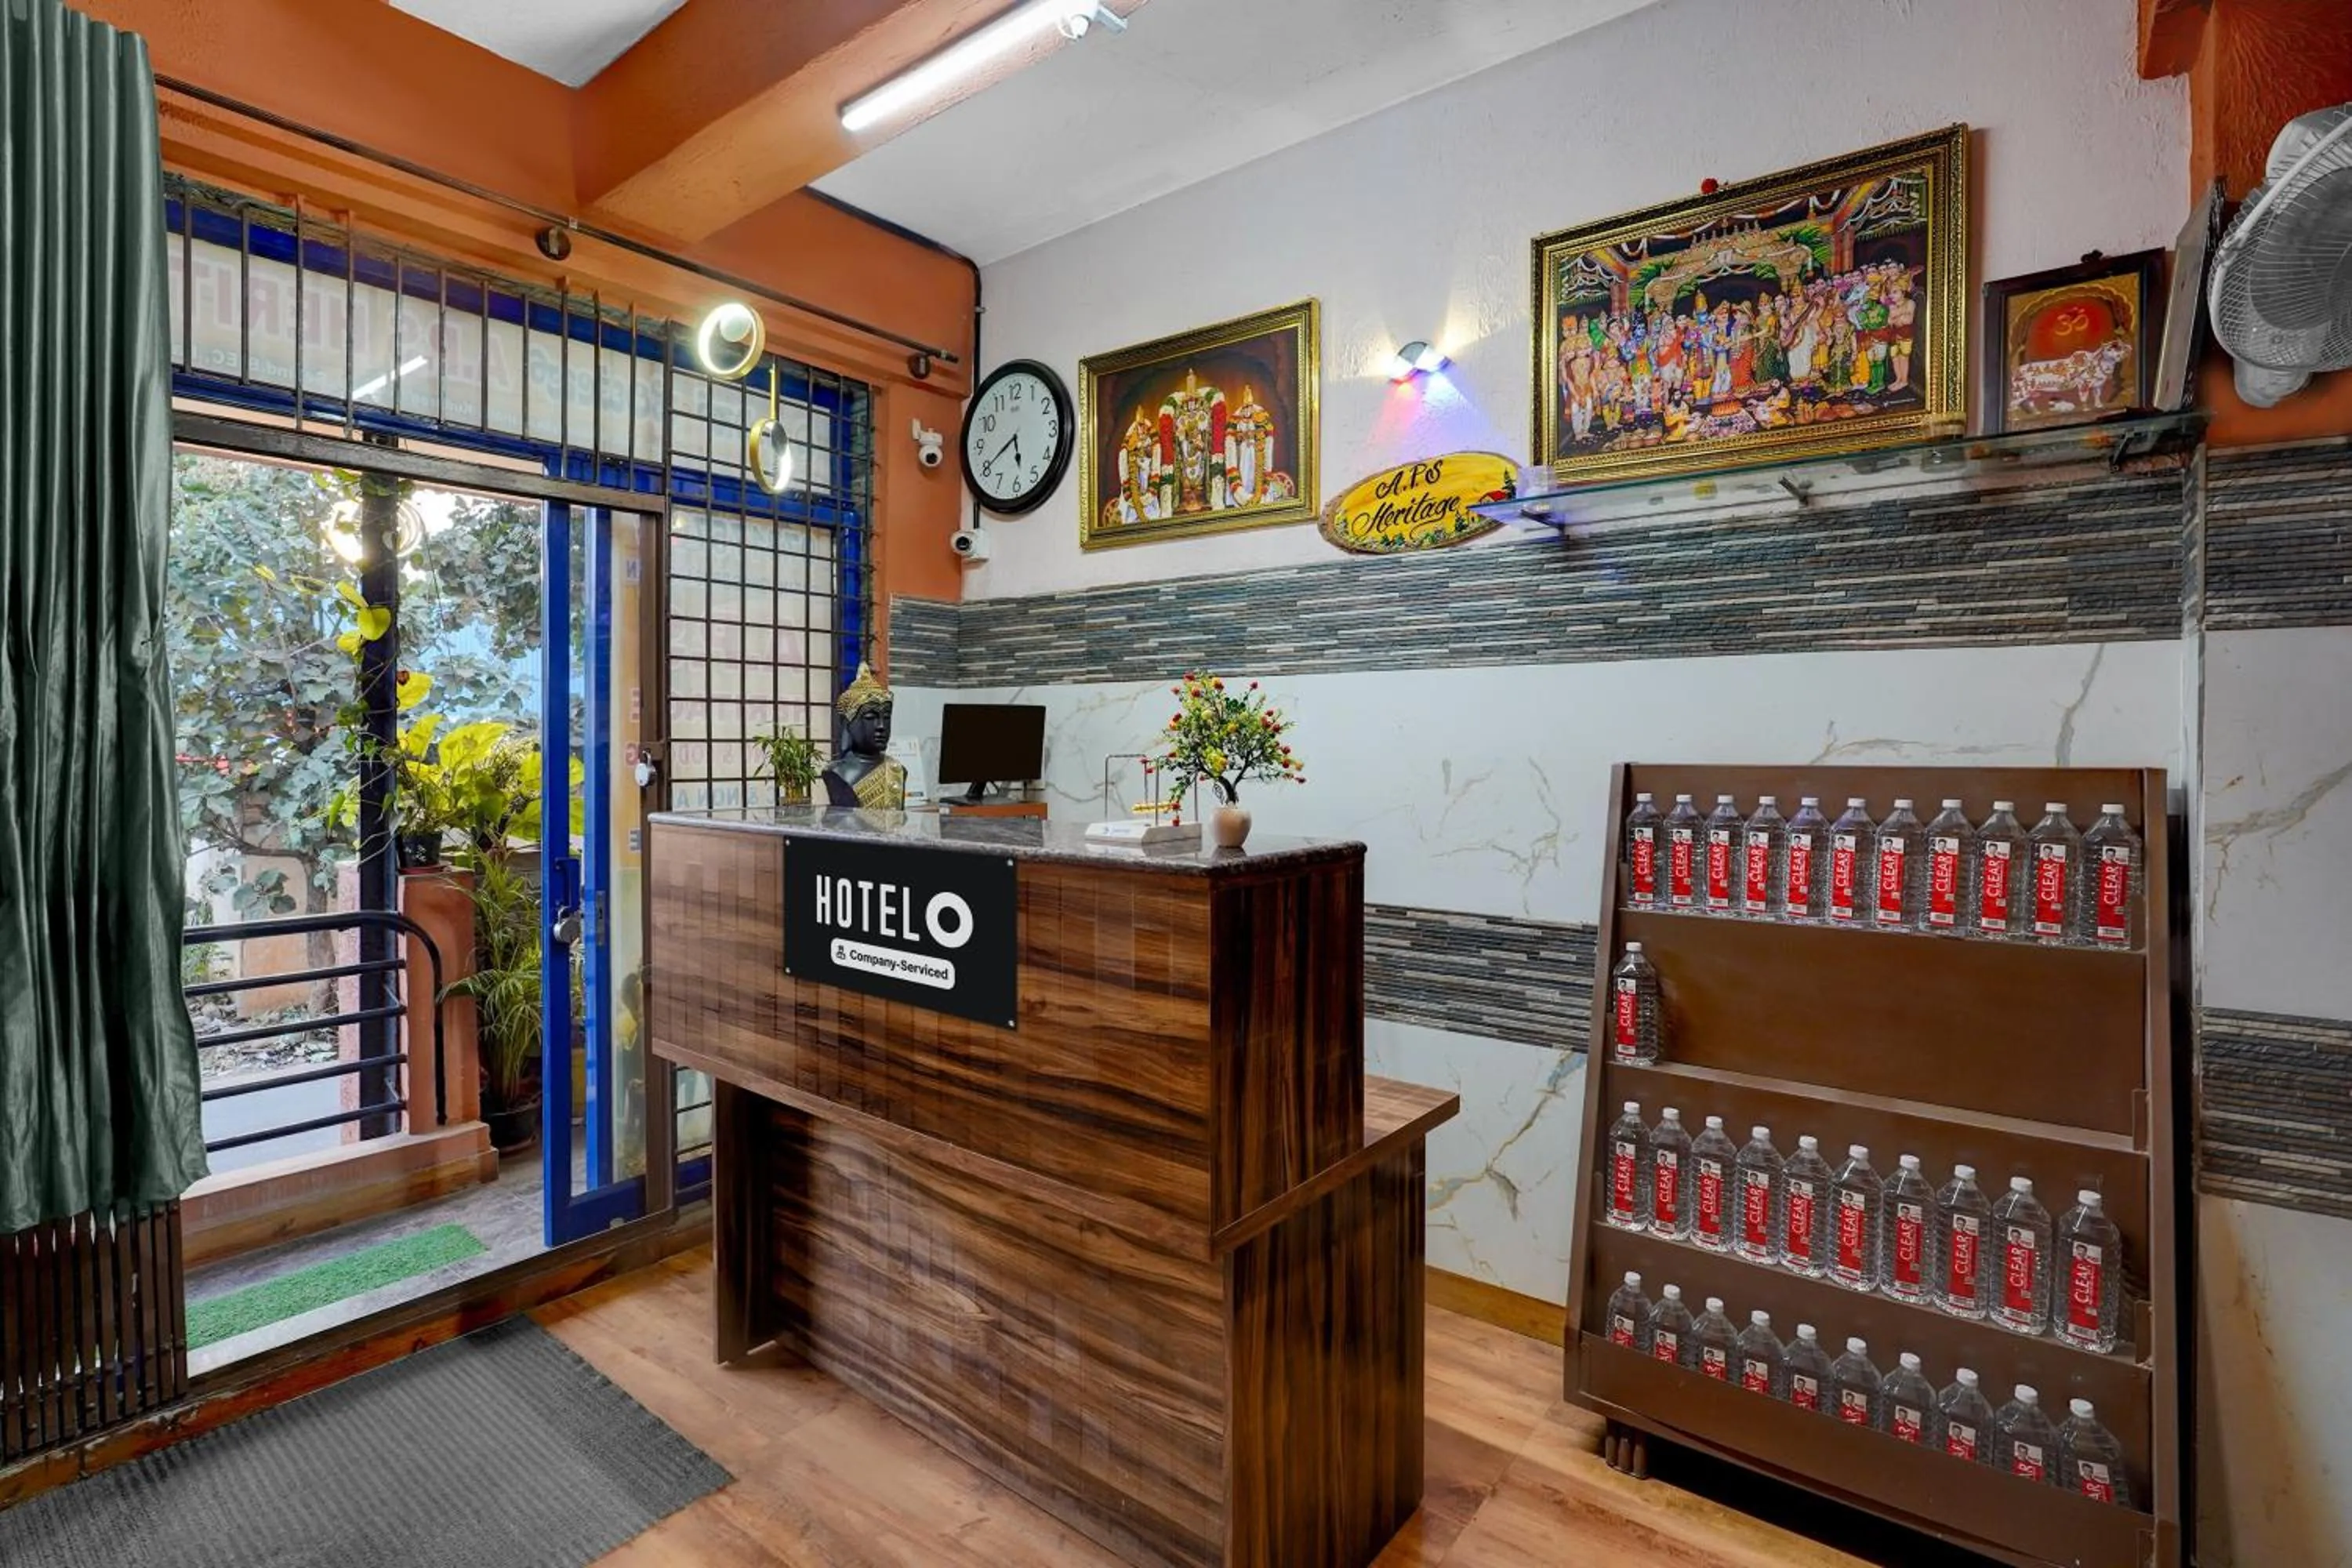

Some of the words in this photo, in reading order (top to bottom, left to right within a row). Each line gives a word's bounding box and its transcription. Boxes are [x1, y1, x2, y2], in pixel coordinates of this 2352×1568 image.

[993, 394, 1006, 412] 11
[1008, 382, 1022, 401] 12
[1041, 397, 1051, 416] 2
[980, 414, 996, 433] 10
[1048, 420, 1058, 439] 3
[976, 438, 985, 456] 9
[1042, 445, 1051, 462] 4
[982, 460, 992, 478] 8
[995, 472, 1004, 490] 7
[1012, 475, 1022, 493] 6
[1029, 465, 1040, 484] 5
[1351, 492, 1463, 541] Heritage
[1637, 844, 1647, 875] CLEAR
[1675, 844, 1686, 877] CLEAR
[1711, 846, 1723, 880] CLEAR
[1748, 848, 1761, 882] CLEAR
[1792, 851, 1802, 885] CLEAR
[1835, 852, 1846, 887] CLEAR
[1882, 854, 1895, 891] CLEAR
[1936, 855, 1949, 891] CLEAR
[1986, 860, 2001, 897] CLEAR
[2041, 863, 2057, 902] CLEAR
[2103, 866, 2119, 905] CLEAR
[815, 874, 920, 942] HOTEL
[848, 949, 949, 981] Company-Serviced
[1620, 992, 1632, 1027] CLEAR
[1617, 1156, 1630, 1192] CLEAR
[1659, 1168, 1670, 1203] CLEAR
[1702, 1178, 1714, 1213] CLEAR
[1749, 1188, 1760, 1224] CLEAR
[1791, 1197, 1803, 1234] CLEAR
[1843, 1208, 1856, 1247] CLEAR
[1900, 1222, 1913, 1261] CLEAR
[1955, 1235, 1969, 1274] CLEAR
[2009, 1247, 2024, 1287] CLEAR
[2074, 1263, 2090, 1303] CLEAR
